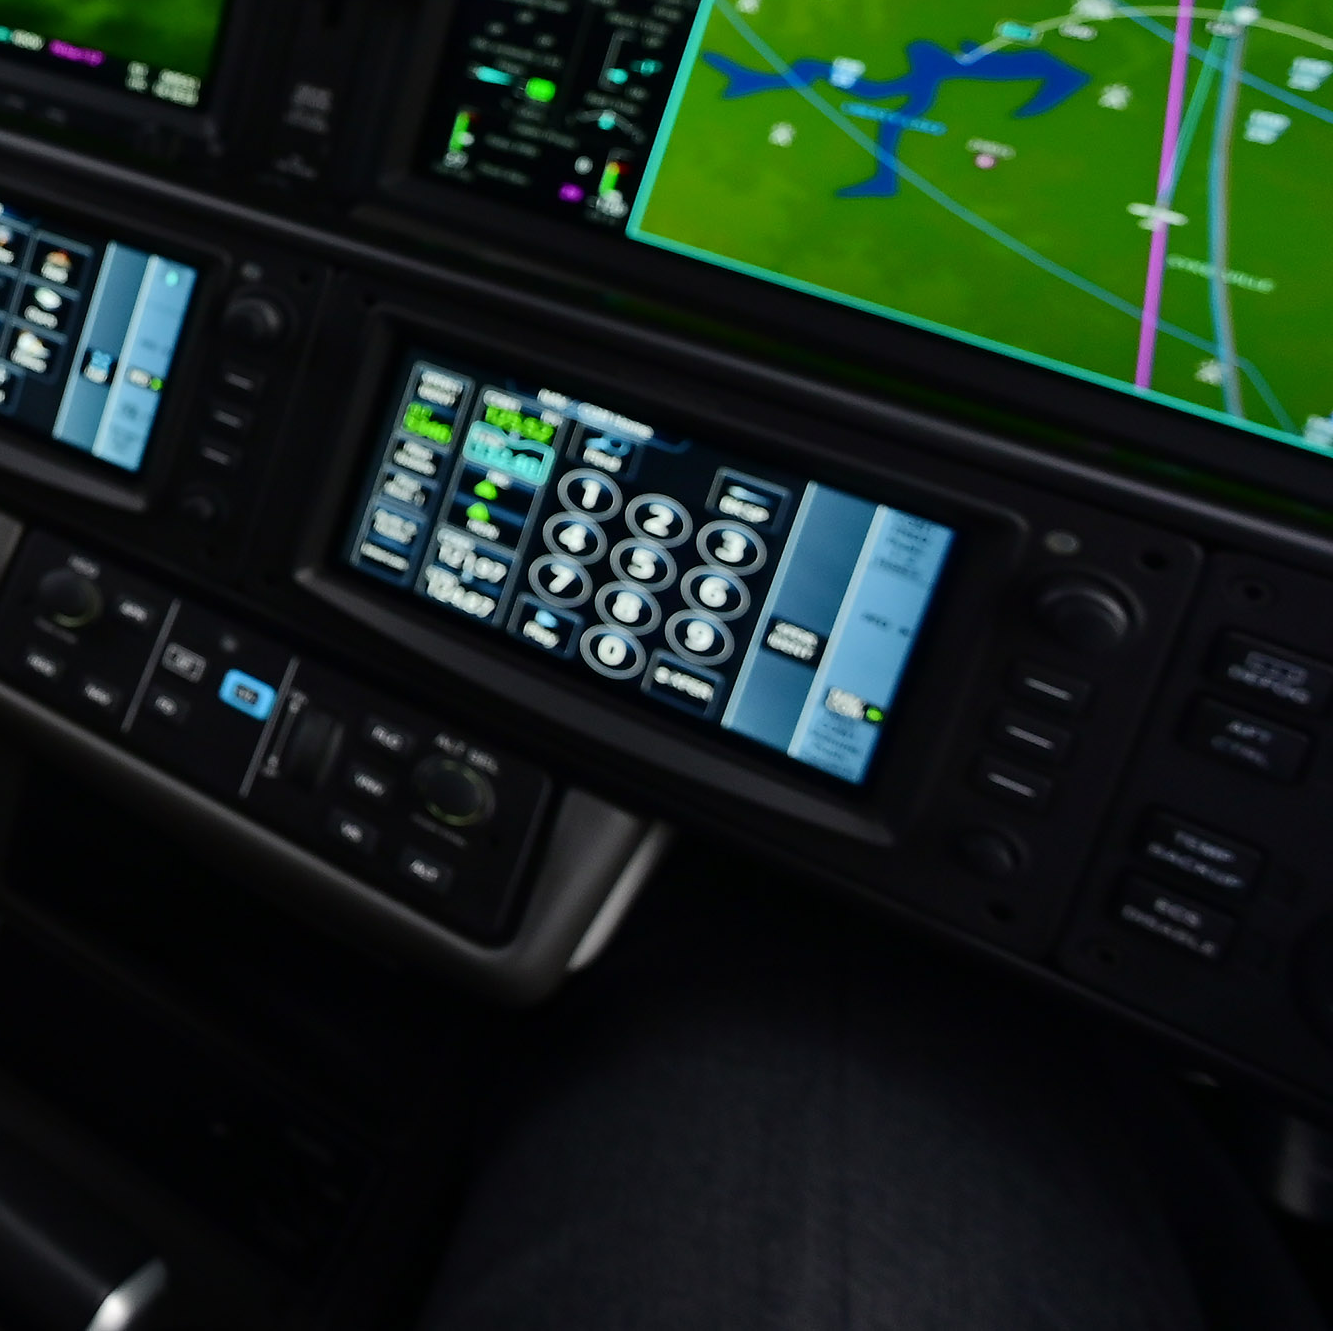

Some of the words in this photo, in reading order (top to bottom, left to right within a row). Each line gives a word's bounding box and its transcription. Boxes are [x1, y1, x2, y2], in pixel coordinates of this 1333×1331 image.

[581, 479, 601, 509] 1
[643, 503, 674, 537] 2
[558, 523, 587, 553] 4
[714, 530, 747, 563] 3
[548, 564, 577, 594] 7
[627, 548, 658, 580] 5
[612, 591, 643, 623] 8
[699, 576, 730, 608] 6
[597, 634, 627, 666] 0
[684, 620, 715, 652] 9
